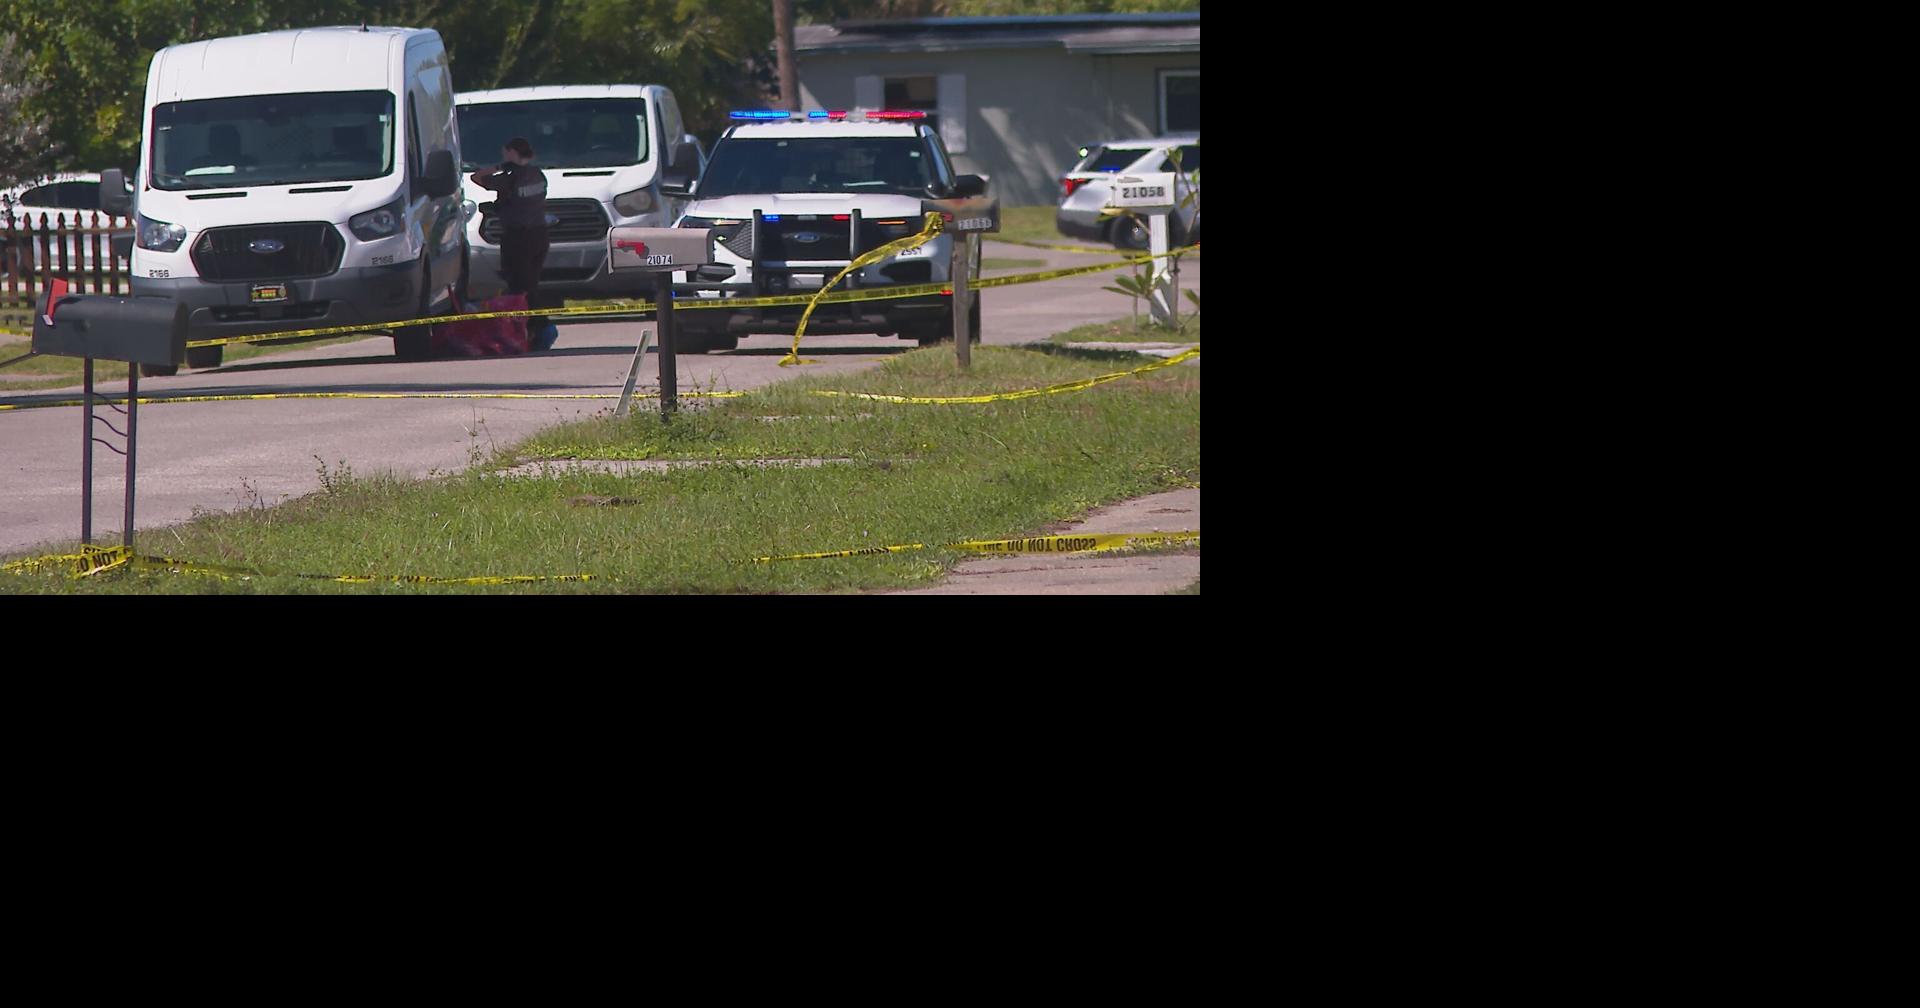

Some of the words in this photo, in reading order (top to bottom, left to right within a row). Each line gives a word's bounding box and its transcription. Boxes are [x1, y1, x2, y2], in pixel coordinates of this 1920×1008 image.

[1122, 186, 1164, 198] 21058
[647, 255, 673, 265] 21074
[93, 550, 118, 568] NOT
